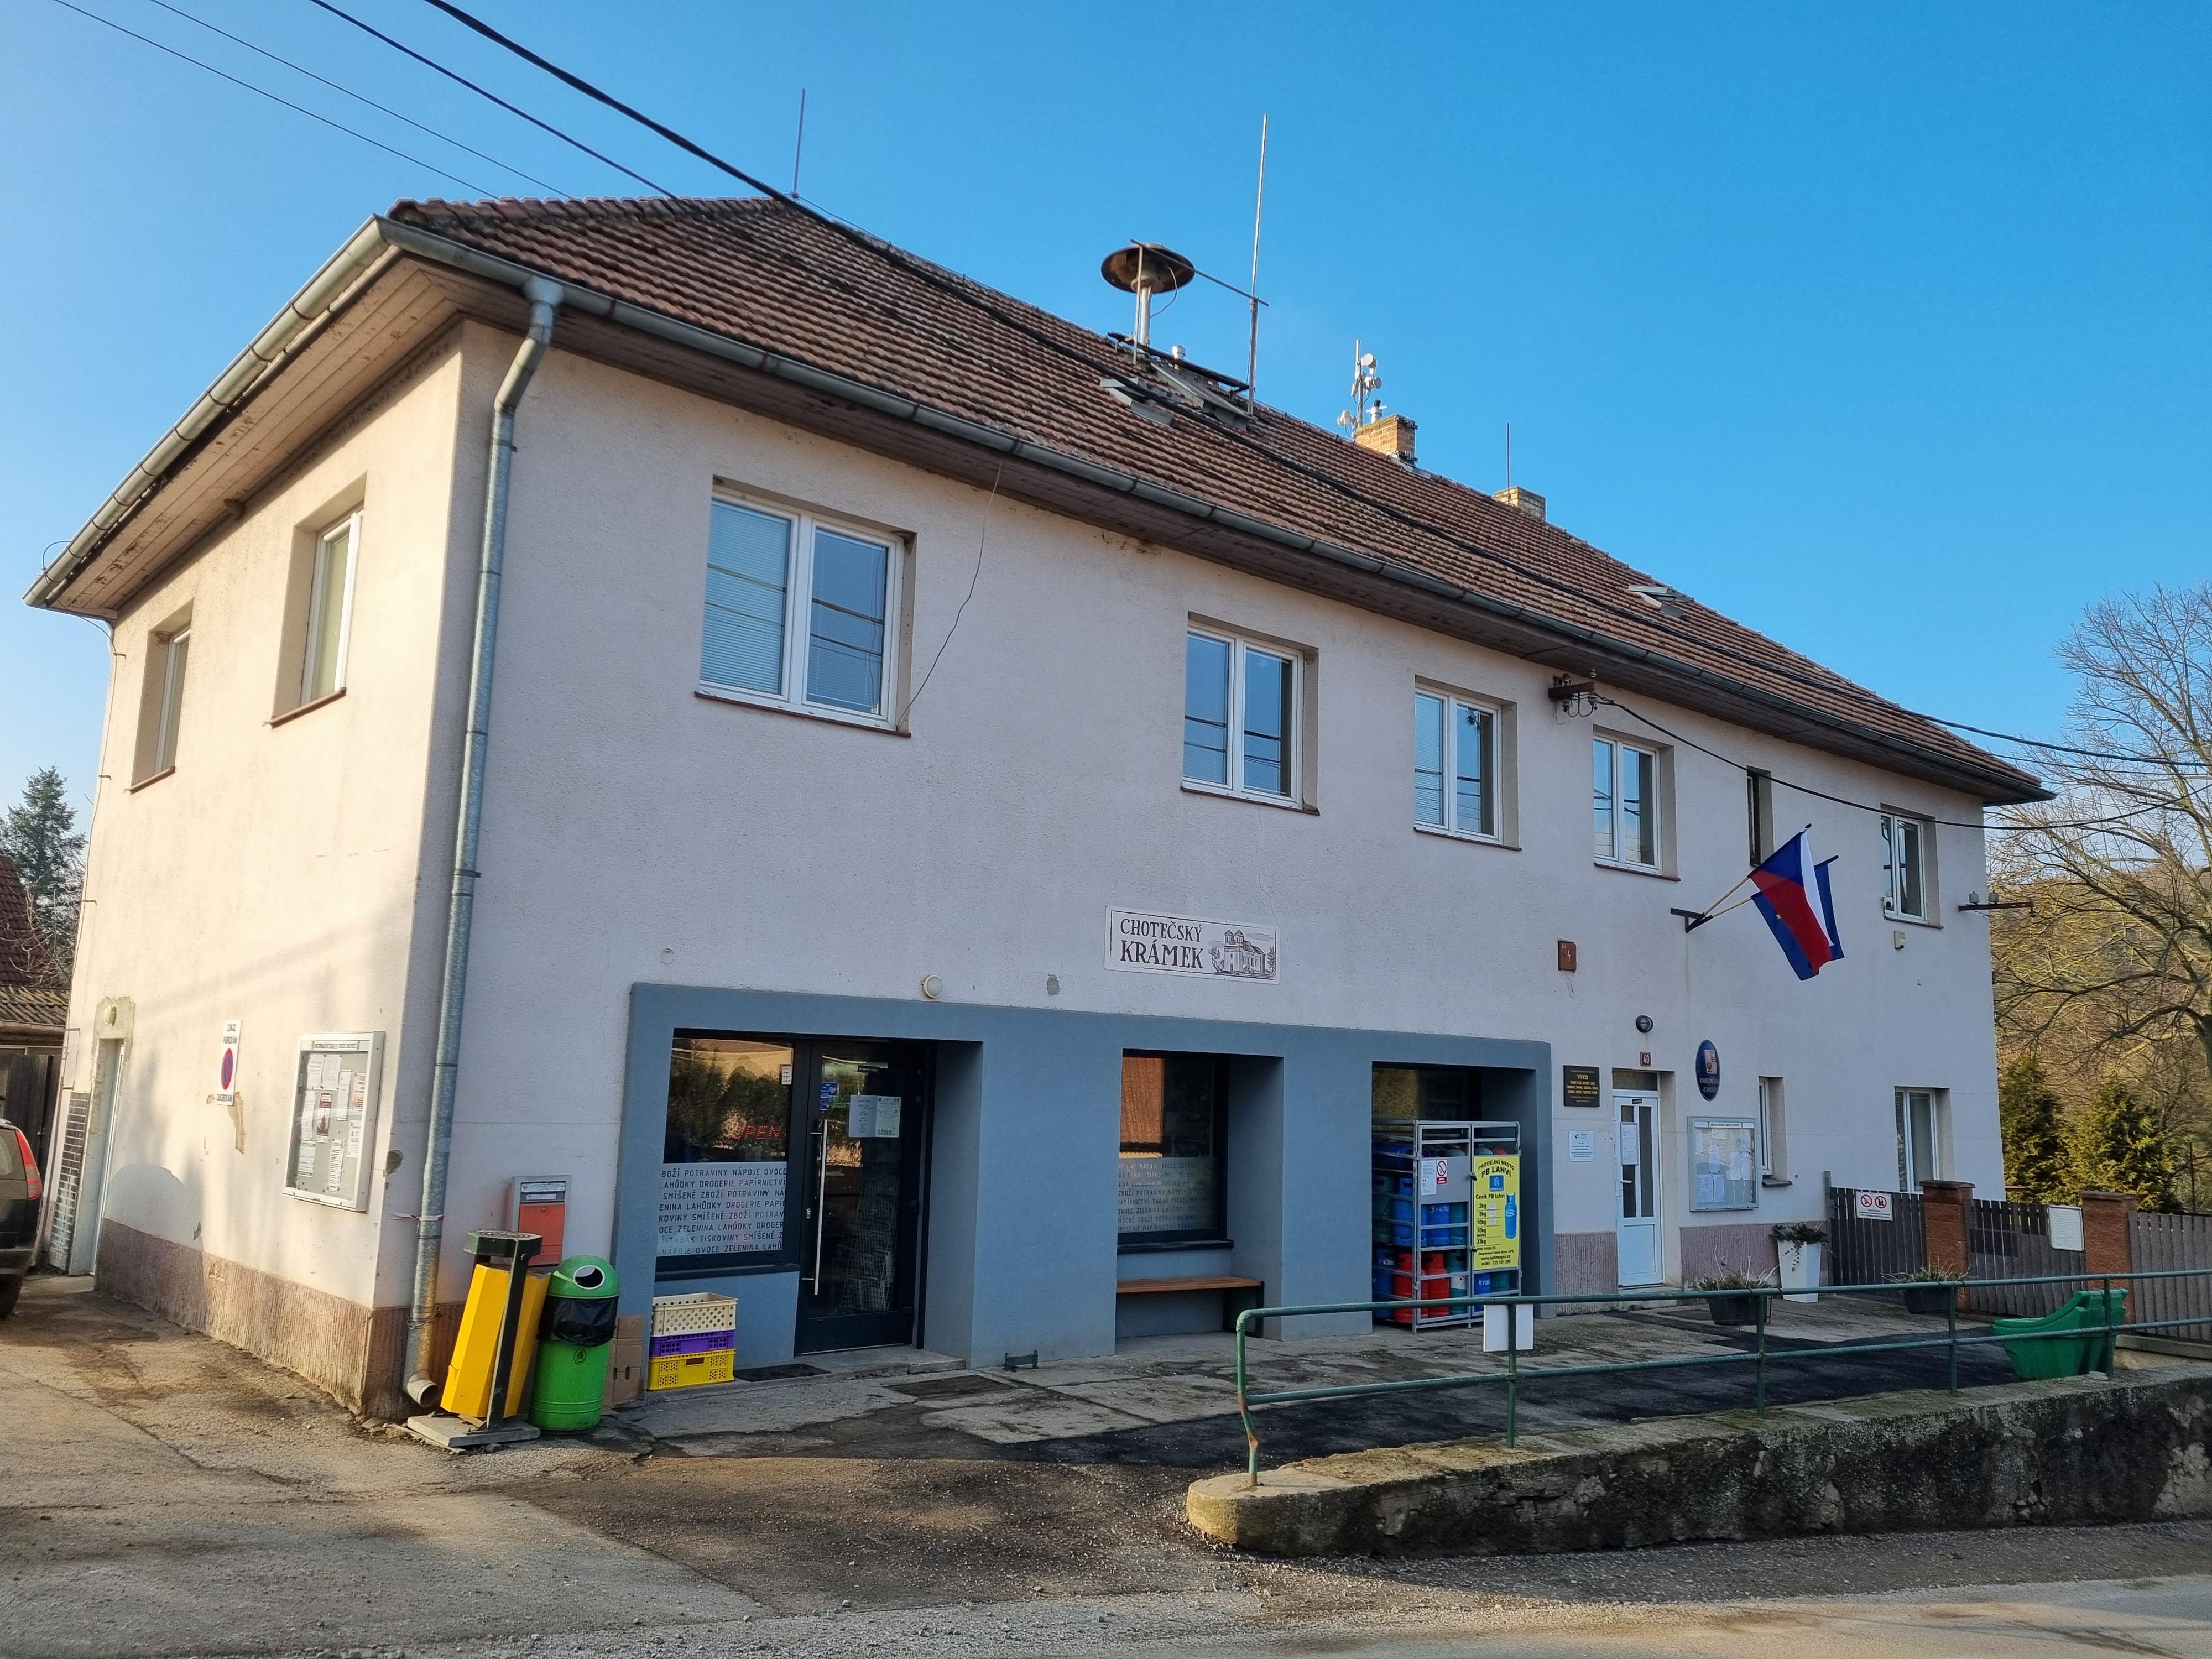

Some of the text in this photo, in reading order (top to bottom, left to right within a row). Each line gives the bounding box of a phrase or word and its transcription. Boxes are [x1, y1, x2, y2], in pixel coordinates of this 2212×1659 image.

[1120, 918, 1203, 942] CHOTEČSKÝ
[1120, 939, 1204, 969] KRÁMEK
[1643, 1054, 1650, 1064] 40
[731, 1125, 782, 1140] OPEN
[1478, 1159, 1515, 1171] PRODEJNÍ MÍSTO
[662, 1168, 680, 1177] BOŽÍ
[733, 1167, 760, 1176] NÁPOJE
[1481, 1166, 1511, 1178] PB LAHVÍ
[660, 1179, 695, 1188] AHŮDKY
[739, 1176, 786, 1186] PAPÍRNICTVÍ
[663, 1190, 696, 1199] SMÍŠENÉ
[701, 1189, 723, 1198] ZBOŽÍ
[775, 1187, 784, 1196] NÁ
[687, 1200, 722, 1210] LAHŮDKY
[692, 1211, 724, 1220] SMÍŠENÉ
[729, 1210, 750, 1219] ZBOŽÍ
[677, 1224, 713, 1233] ZELENINA
[718, 1221, 752, 1230] LAHŮDKY
[700, 1234, 739, 1243] TISKOVINY
[744, 1230, 775, 1240] SMÍŠENÉ
